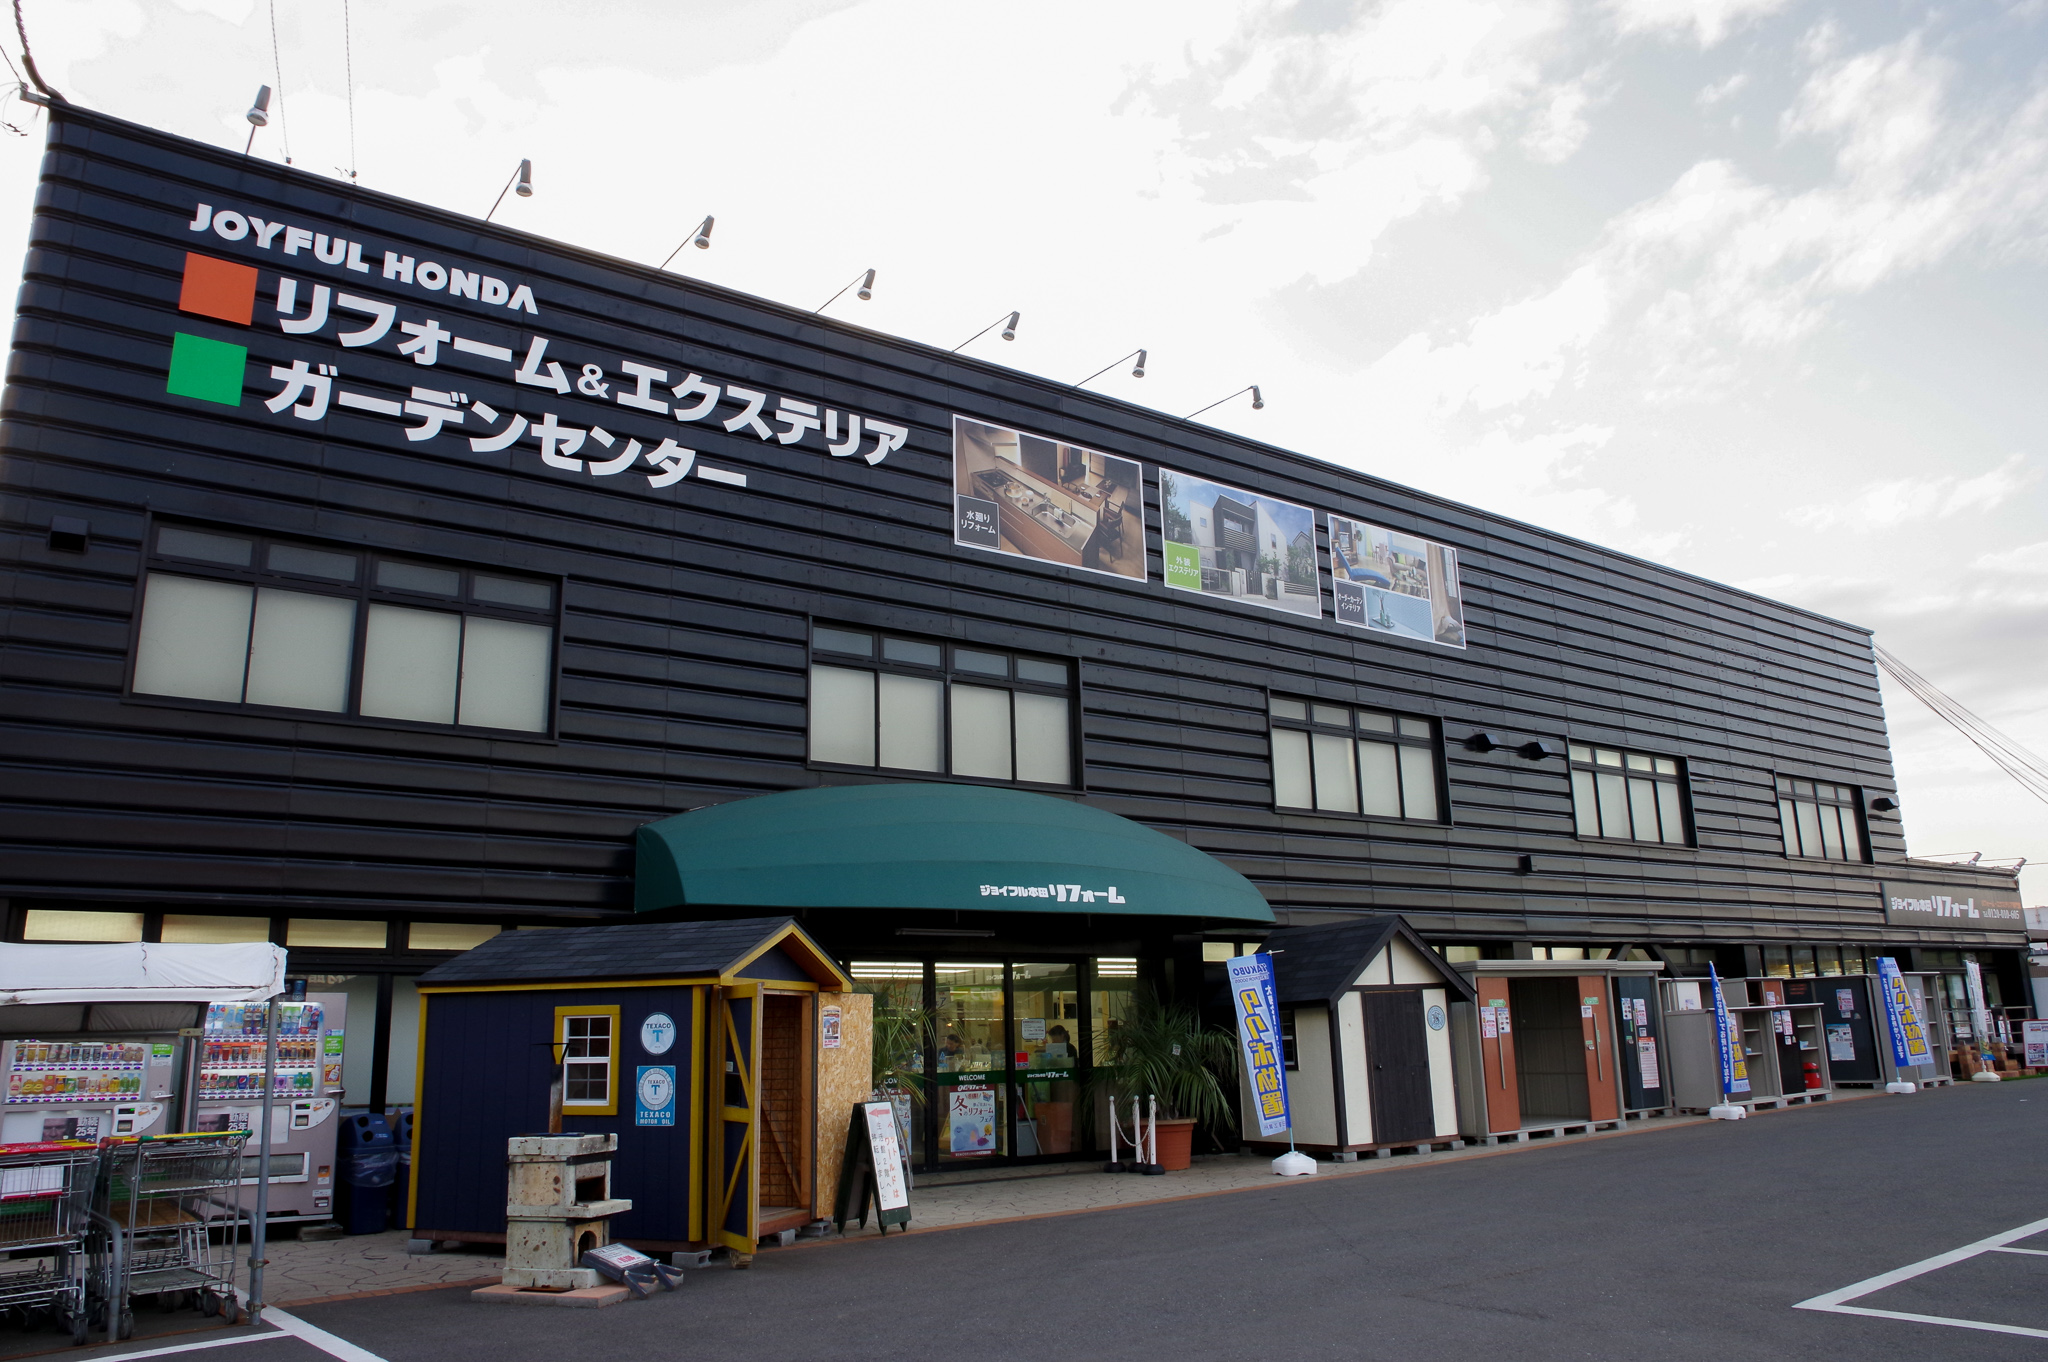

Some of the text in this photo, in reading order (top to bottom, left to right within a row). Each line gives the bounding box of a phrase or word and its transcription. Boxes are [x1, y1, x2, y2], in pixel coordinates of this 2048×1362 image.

[189, 203, 538, 316] JOYFUL HONDA
[275, 277, 909, 467] リフォーム&エクステリア
[263, 359, 748, 490] ガーデンセンター
[966, 510, 990, 523] 水廻り
[961, 519, 996, 534] リフォーム
[1175, 556, 1191, 567] 外装
[1168, 564, 1199, 577] エクステリア
[958, 1073, 986, 1081] WELCOME
[75, 1127, 98, 1136] 25年
